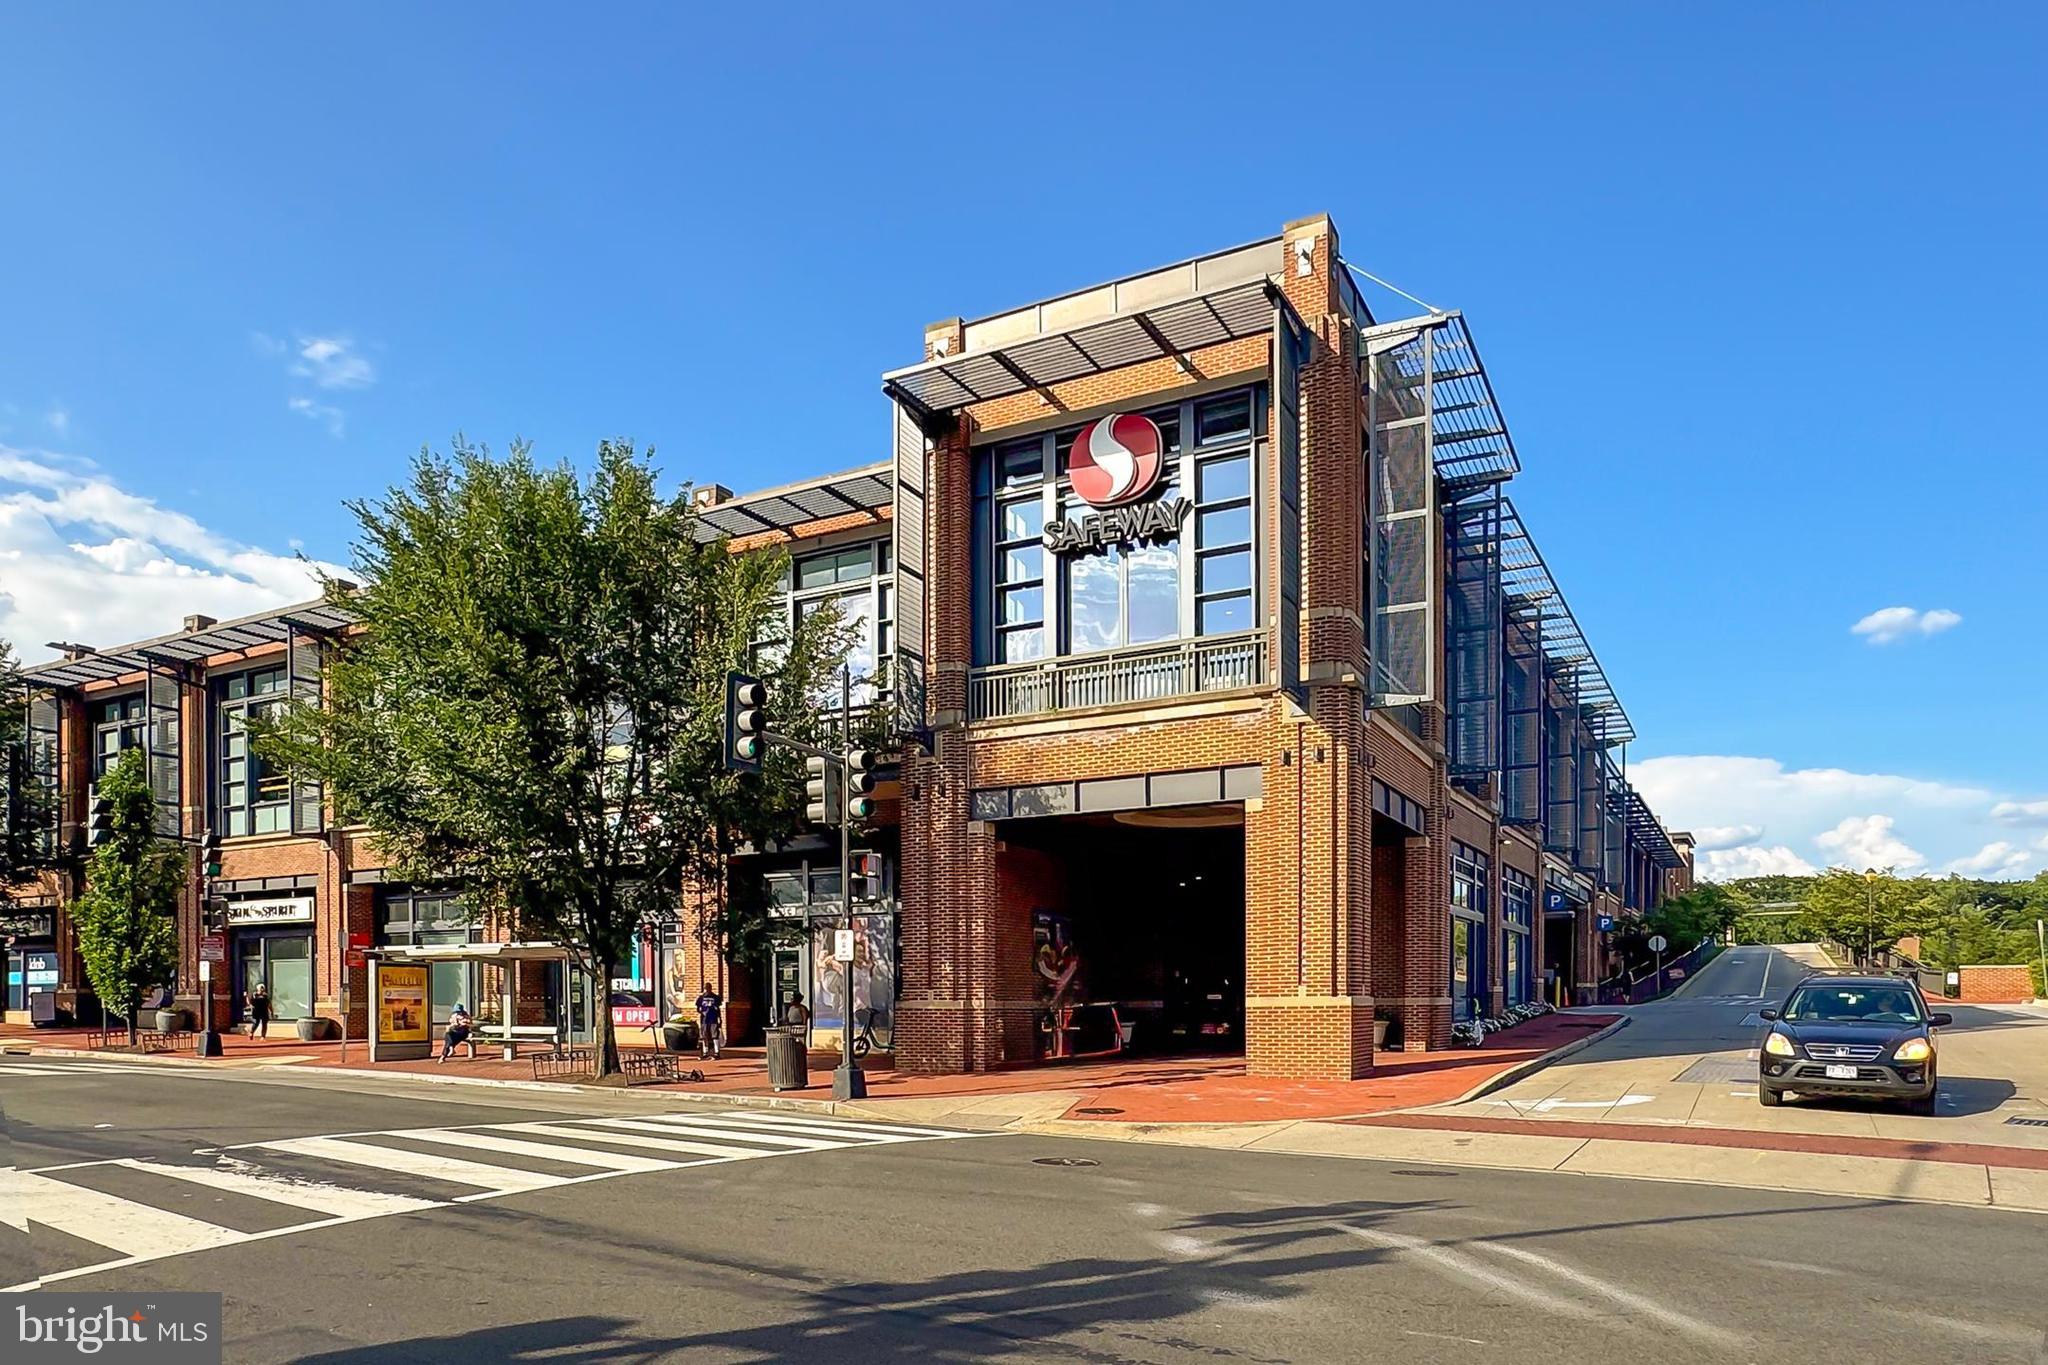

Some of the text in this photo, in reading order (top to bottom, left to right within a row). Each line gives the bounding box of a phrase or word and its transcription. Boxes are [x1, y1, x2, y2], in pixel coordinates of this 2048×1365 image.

[1043, 497, 1193, 553] SAFEWAY
[1550, 895, 1562, 908] P
[1601, 918, 1610, 929] P
[626, 1010, 650, 1022] OPEN
